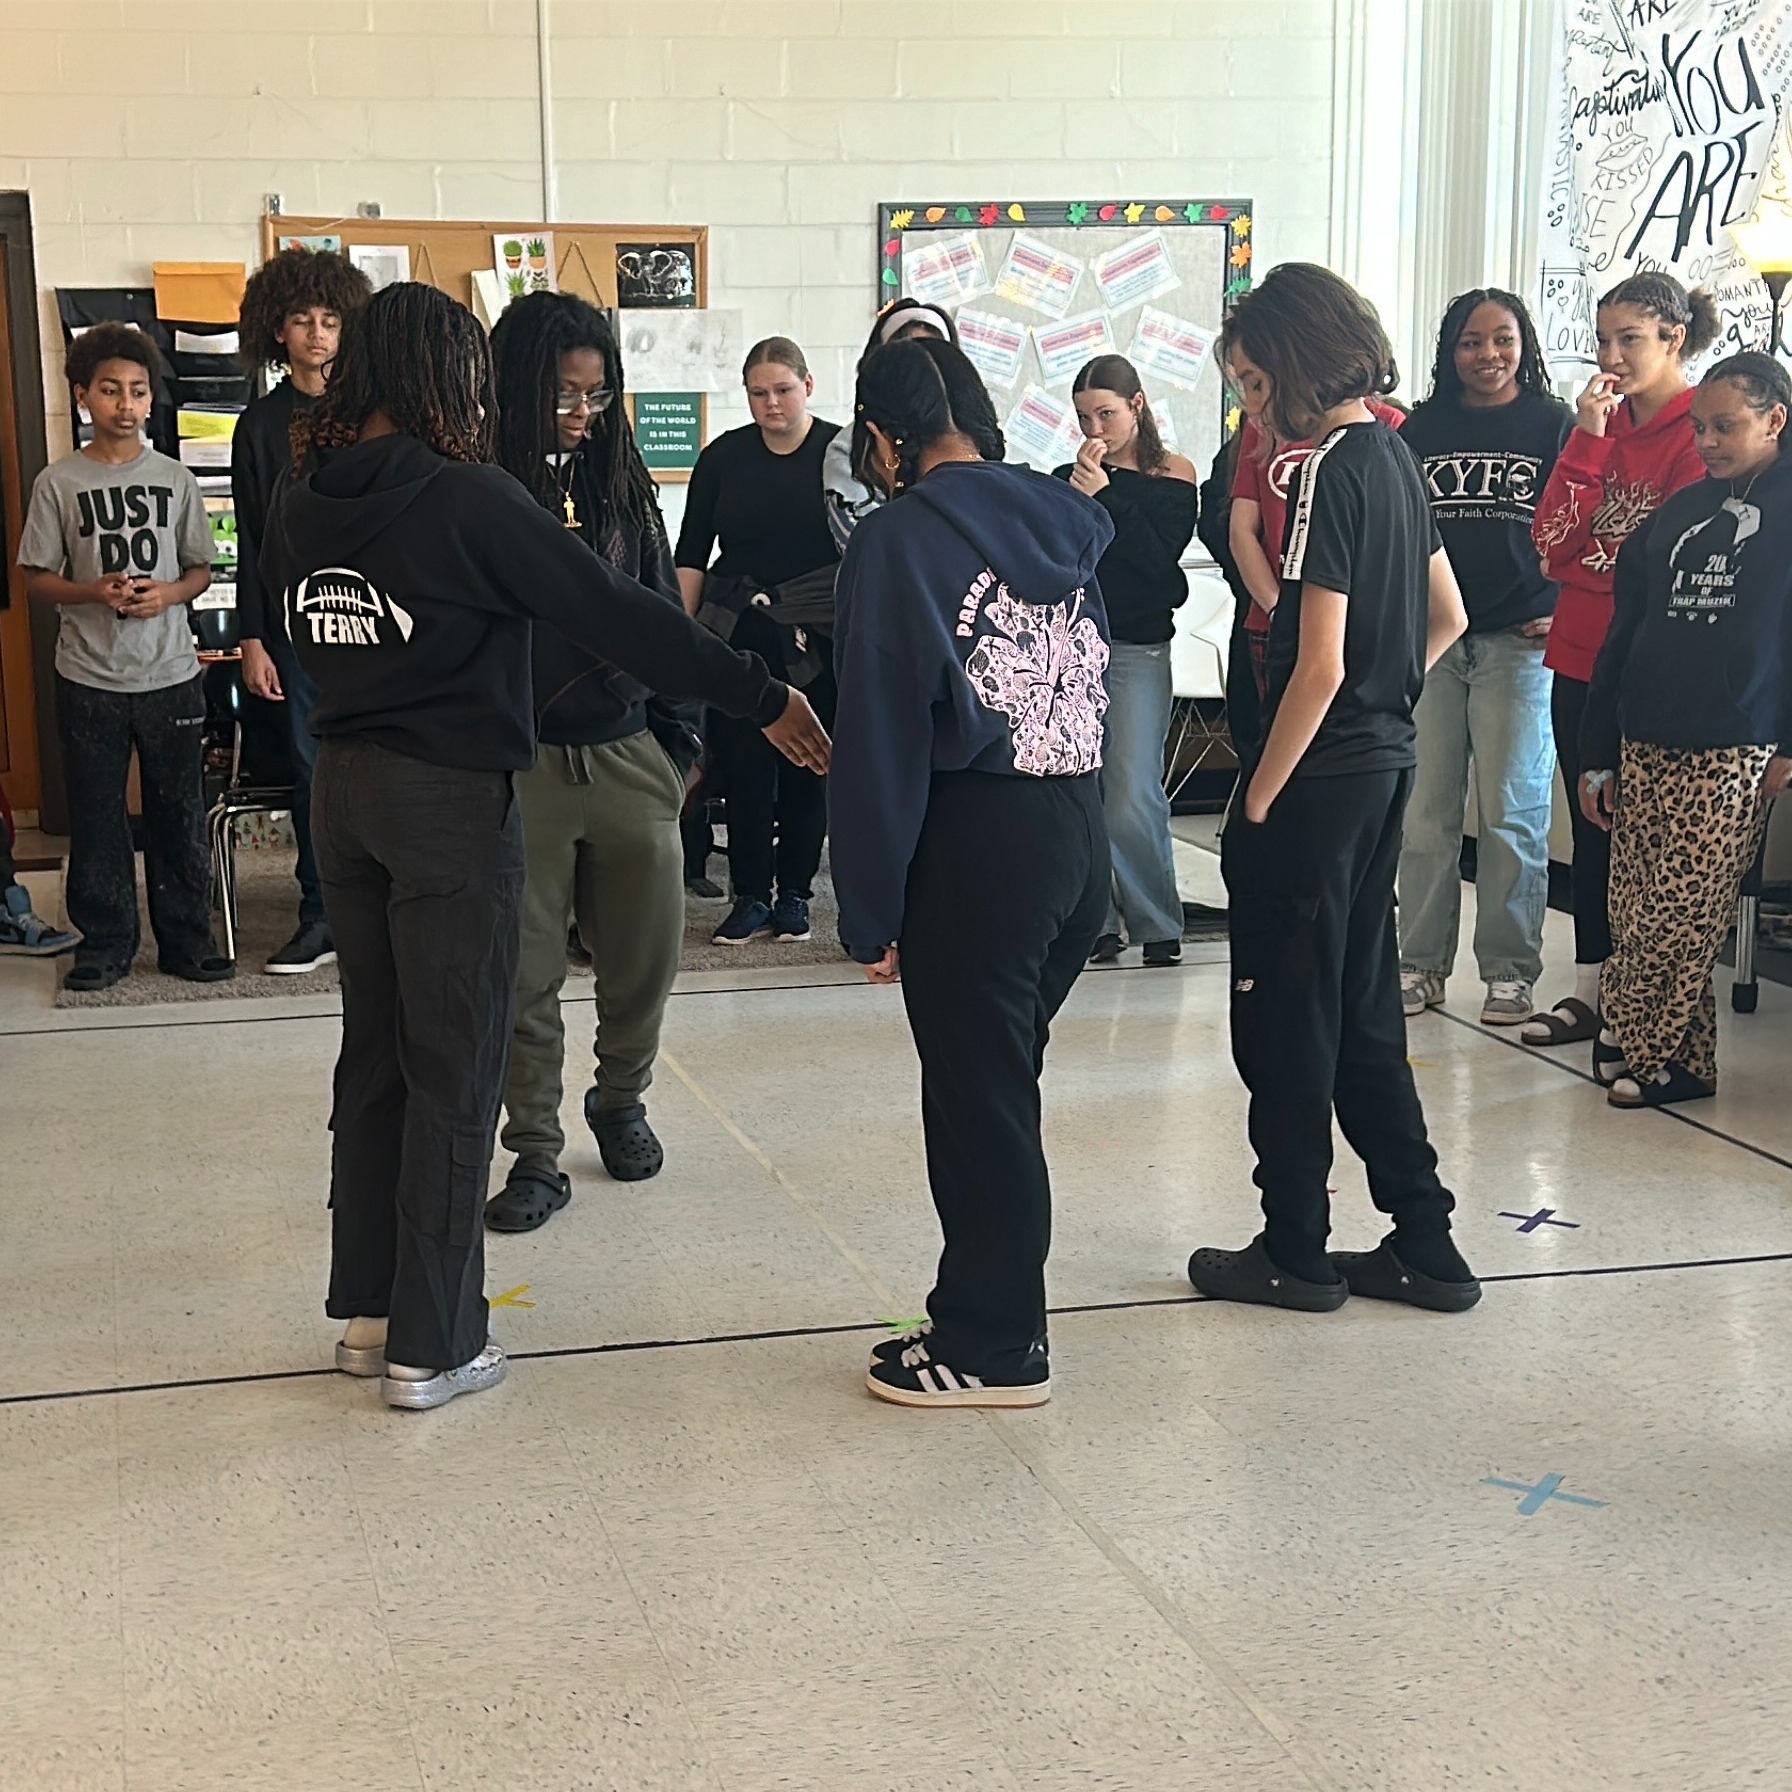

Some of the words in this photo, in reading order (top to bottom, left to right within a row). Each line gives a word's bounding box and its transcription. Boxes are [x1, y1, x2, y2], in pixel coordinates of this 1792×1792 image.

[1661, 29, 1766, 138] YOU
[1623, 120, 1765, 262] ARE
[644, 403, 659, 411] THE
[661, 403, 692, 411] FUTURE
[639, 416, 650, 424] OF
[651, 416, 666, 424] THE
[667, 416, 697, 424] WORLD
[77, 485, 174, 537] JUST
[1435, 509, 1456, 519] Your
[1458, 508, 1483, 518] Faith
[99, 528, 159, 575] DO
[1690, 573, 1735, 587] YEARS
[1701, 586, 1713, 596] OF
[306, 612, 381, 645] TERRY
